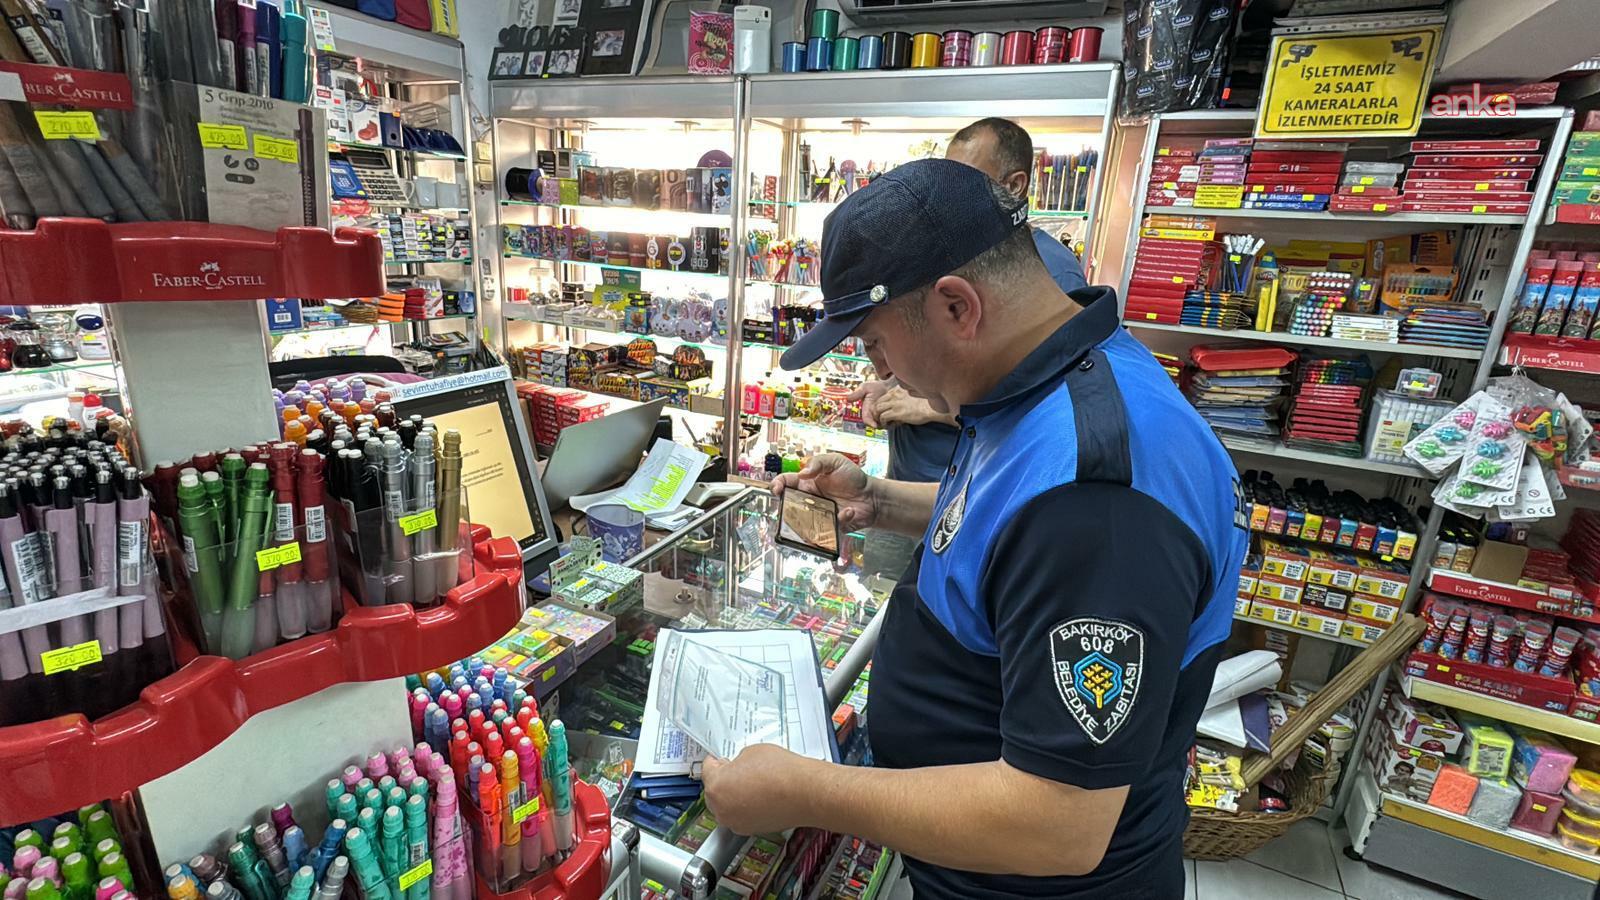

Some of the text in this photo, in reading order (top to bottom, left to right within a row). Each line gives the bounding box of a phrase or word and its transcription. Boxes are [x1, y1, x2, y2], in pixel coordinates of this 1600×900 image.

[1301, 61, 1396, 80] İŞLETMEMİZ
[1314, 81, 1375, 94] 24 SAAT
[1284, 96, 1398, 111] KAMERALARLA
[1278, 110, 1398, 127] İZLENMEKTEDİR
[152, 272, 267, 288] FABER-CASTELL
[402, 369, 508, 397] sevimtuhafiye@hotmail.com
[1059, 623, 1134, 646] BAKIRKÖY
[1080, 637, 1115, 654] 608
[1057, 660, 1139, 732] BELEDİYE ZABITASI
